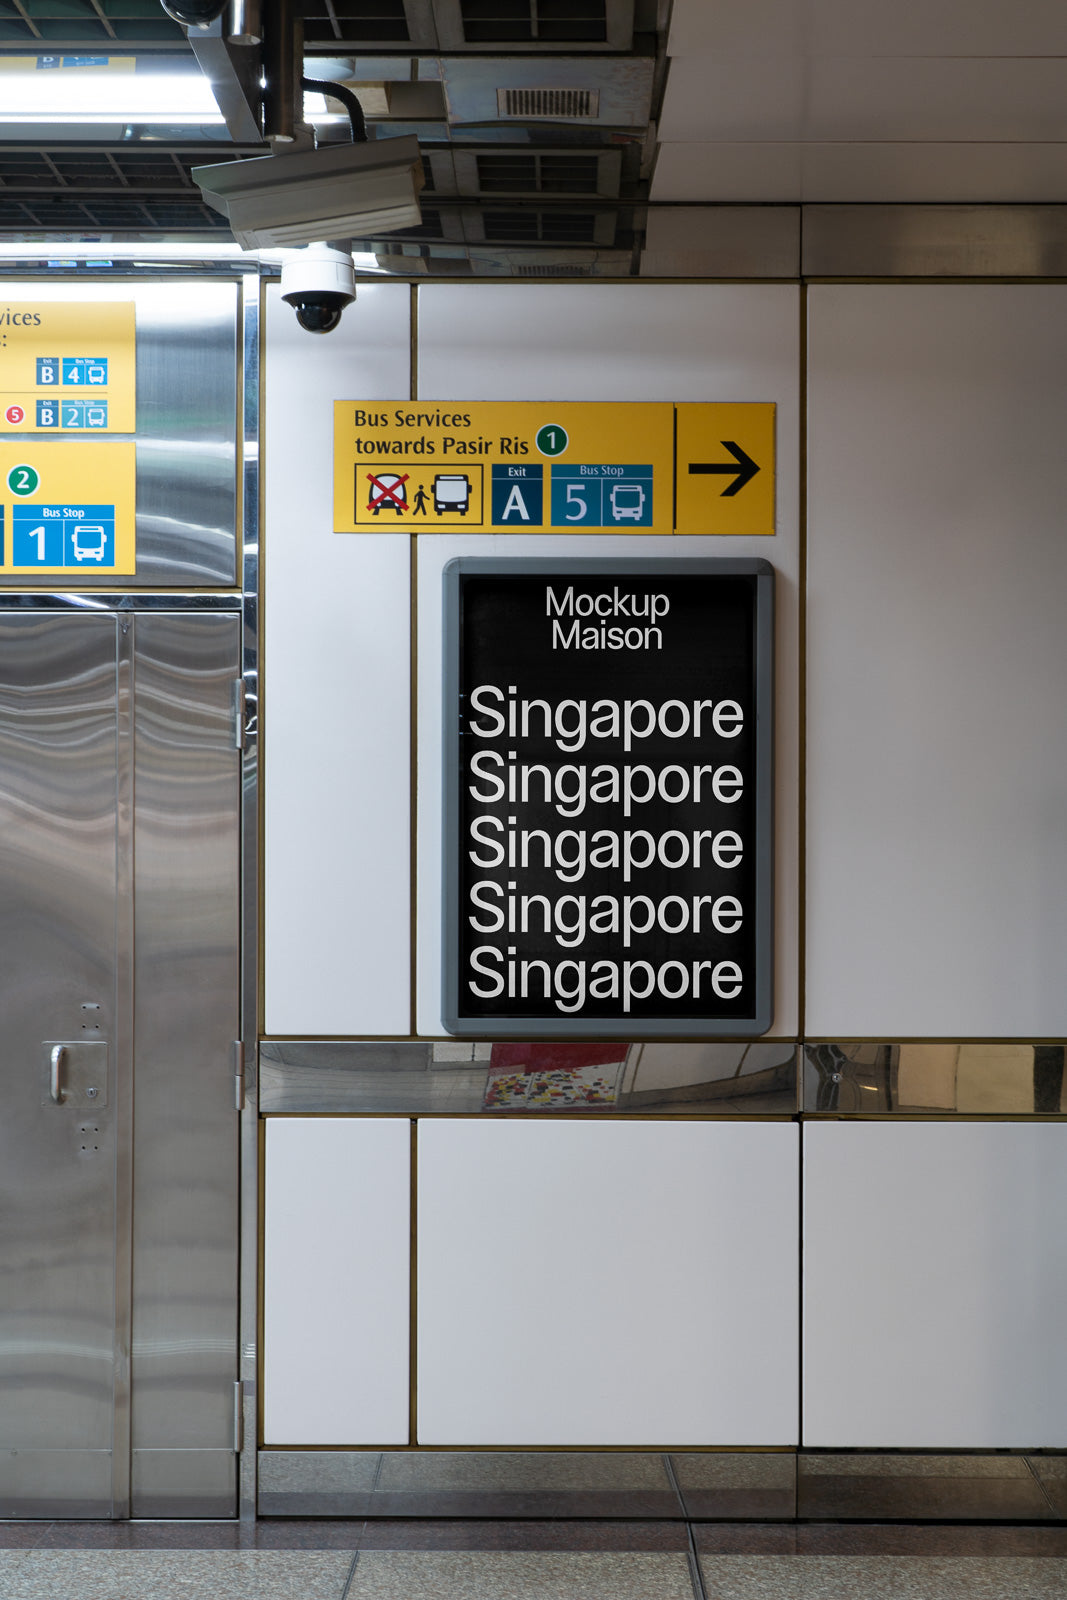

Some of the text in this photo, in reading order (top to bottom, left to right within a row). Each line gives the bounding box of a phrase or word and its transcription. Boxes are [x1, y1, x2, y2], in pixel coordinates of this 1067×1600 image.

[41, 366, 54, 383] B
[68, 366, 80, 383] 4
[11, 409, 20, 422] 5
[41, 408, 54, 425] B
[67, 408, 79, 426] 2
[354, 409, 471, 427] Bus Services
[355, 436, 529, 455] towards Pasir Ris
[546, 431, 556, 449] 1
[16, 470, 30, 489] 2
[508, 467, 526, 477] Exit
[580, 465, 624, 477] Bus Stop
[502, 484, 530, 520] A
[565, 484, 587, 521] 5
[42, 508, 85, 520] Bus Stop
[29, 526, 45, 560] 1
[545, 586, 671, 624] Mockup
[552, 619, 663, 649] Maison
[469, 685, 744, 752] Singapore
[469, 750, 744, 817] Singapore
[469, 815, 744, 882] Singapore
[469, 880, 744, 948] Singapore
[469, 945, 744, 1013] Singapore
